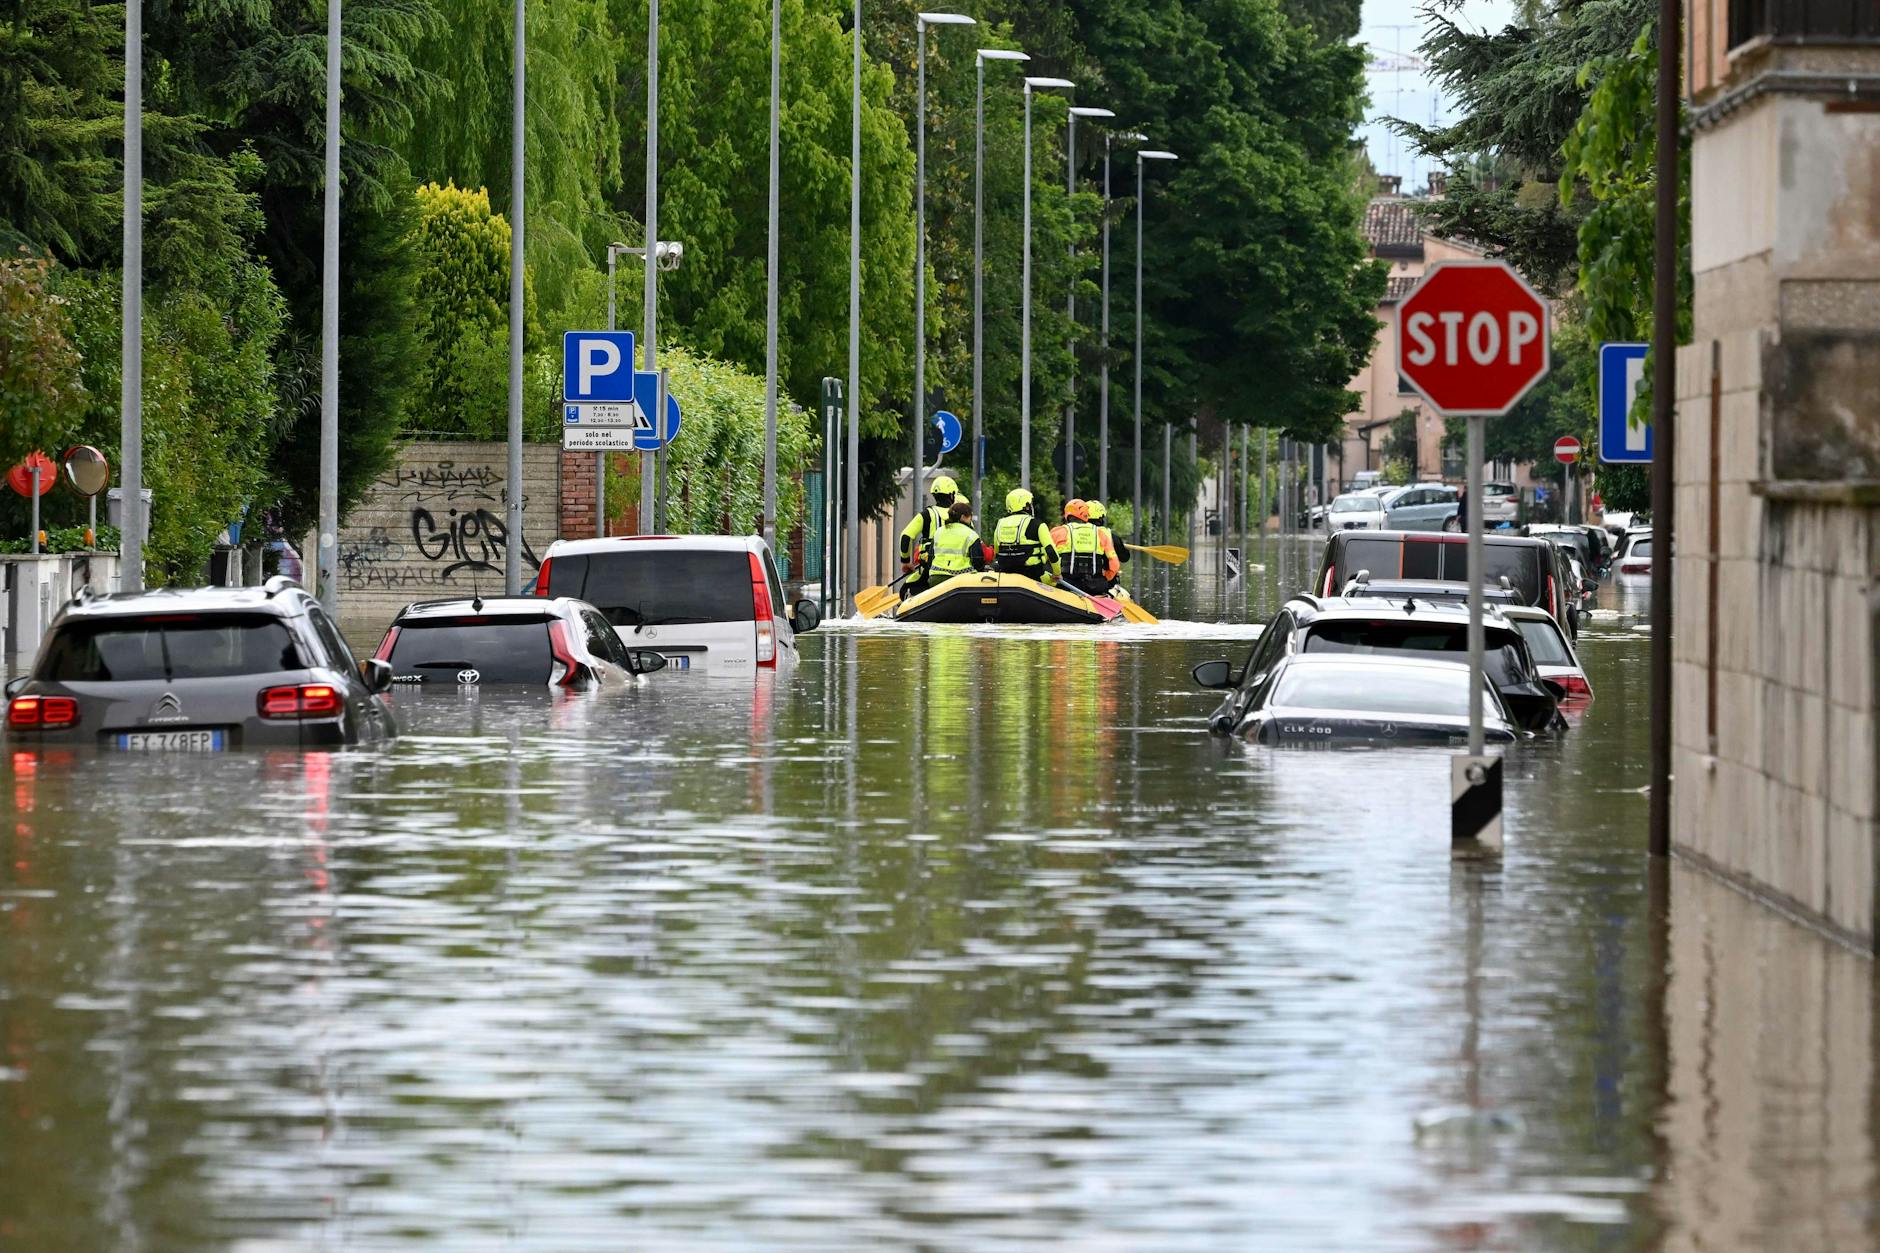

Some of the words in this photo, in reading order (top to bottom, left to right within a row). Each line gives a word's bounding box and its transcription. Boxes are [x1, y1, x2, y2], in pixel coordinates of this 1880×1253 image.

[1407, 311, 1538, 366] STOP
[578, 339, 621, 395] P
[1284, 725, 1305, 733] CLK
[1309, 726, 1332, 735] 200
